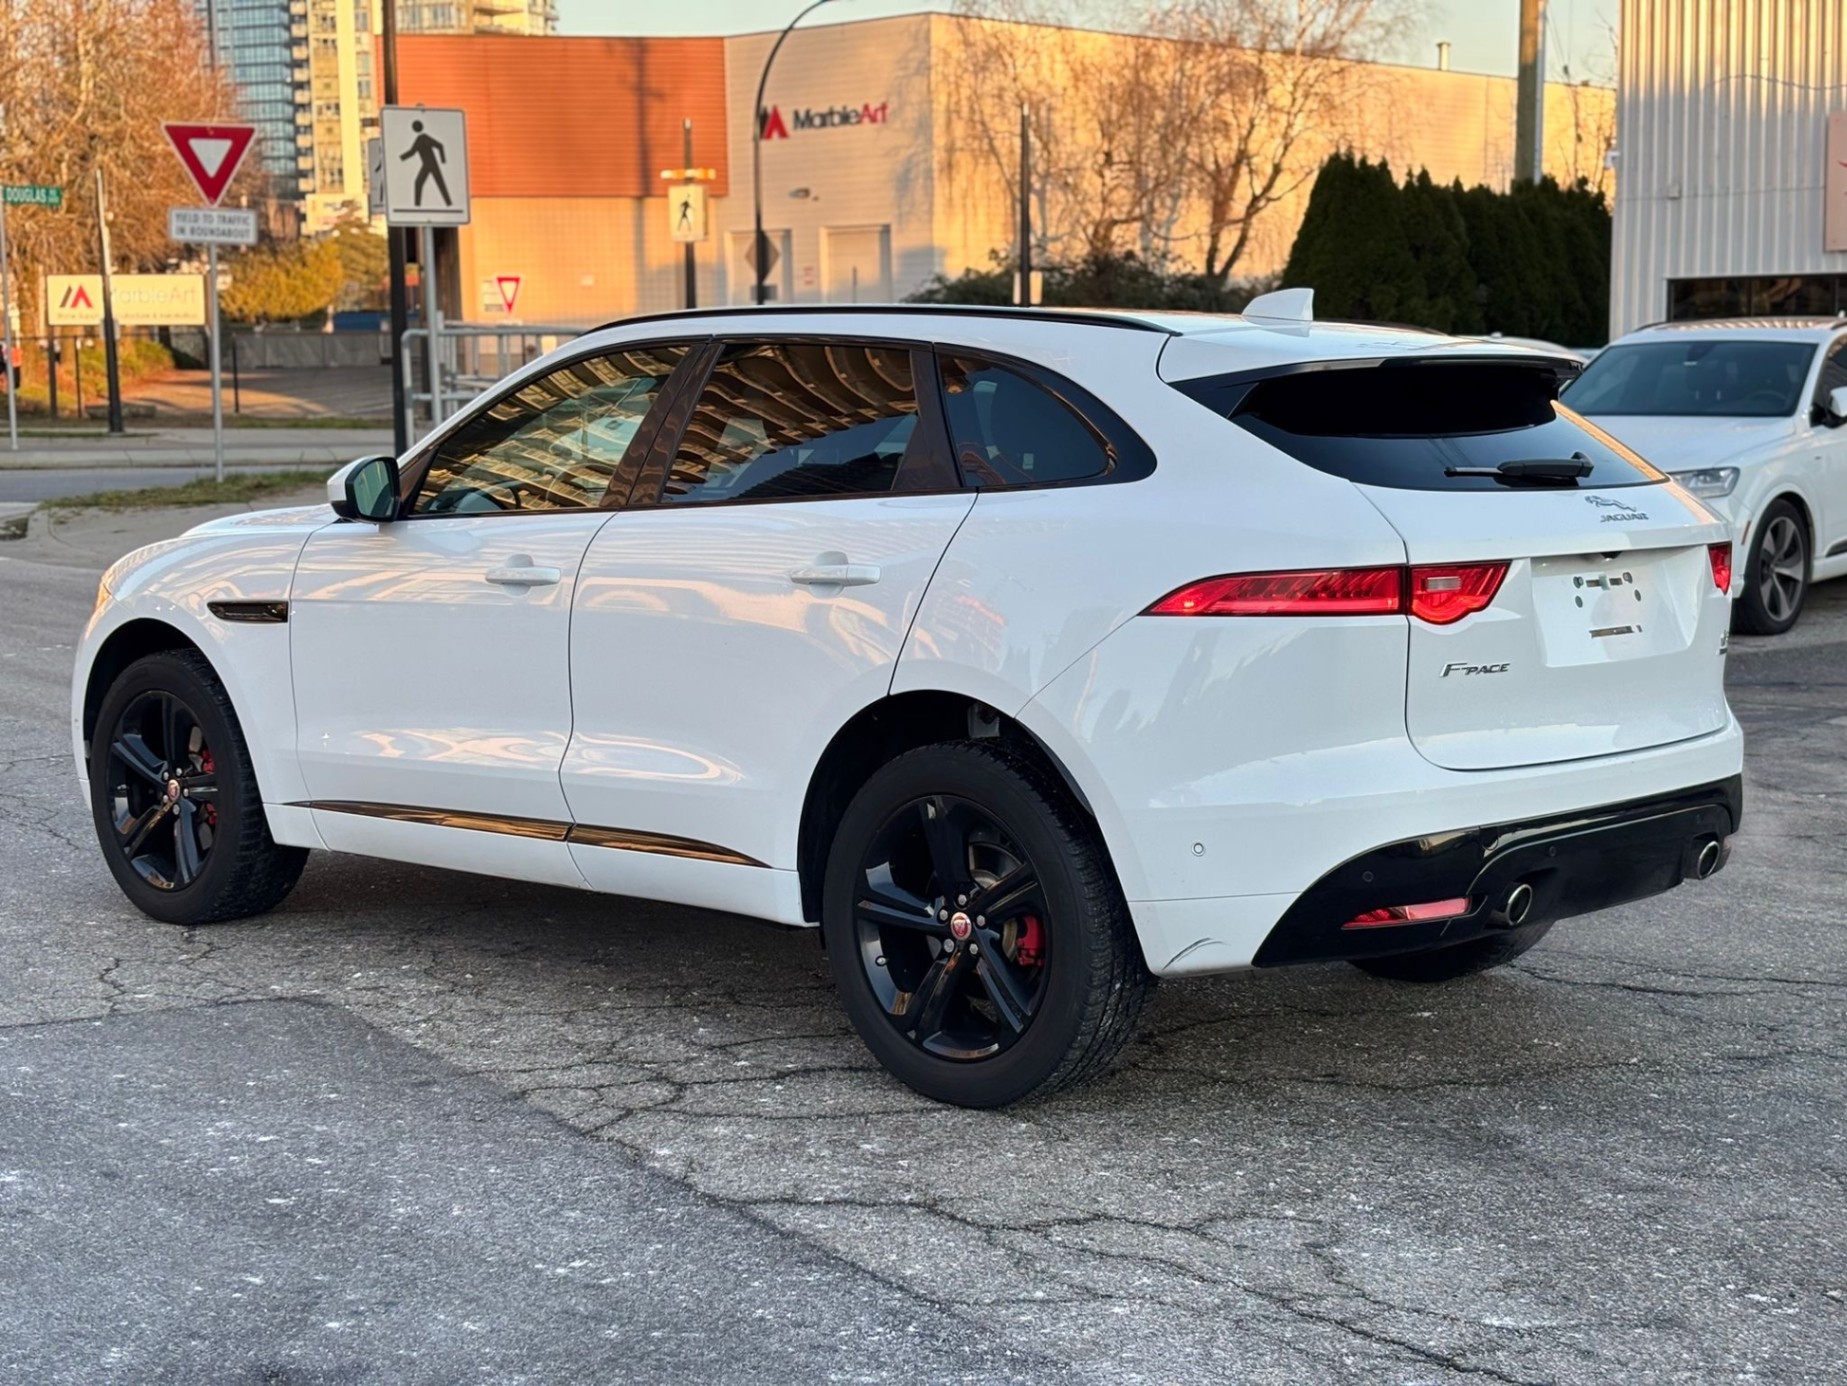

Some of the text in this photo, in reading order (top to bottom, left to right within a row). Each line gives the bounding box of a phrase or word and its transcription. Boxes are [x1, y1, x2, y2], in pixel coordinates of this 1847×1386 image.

[793, 101, 888, 131] MarbleArt
[6, 187, 46, 203] DOUGLAS
[175, 213, 250, 226] YIELD TO TRAFFIC
[190, 226, 250, 239] ROUNDABOUT
[1600, 512, 1649, 523] JAGUAR
